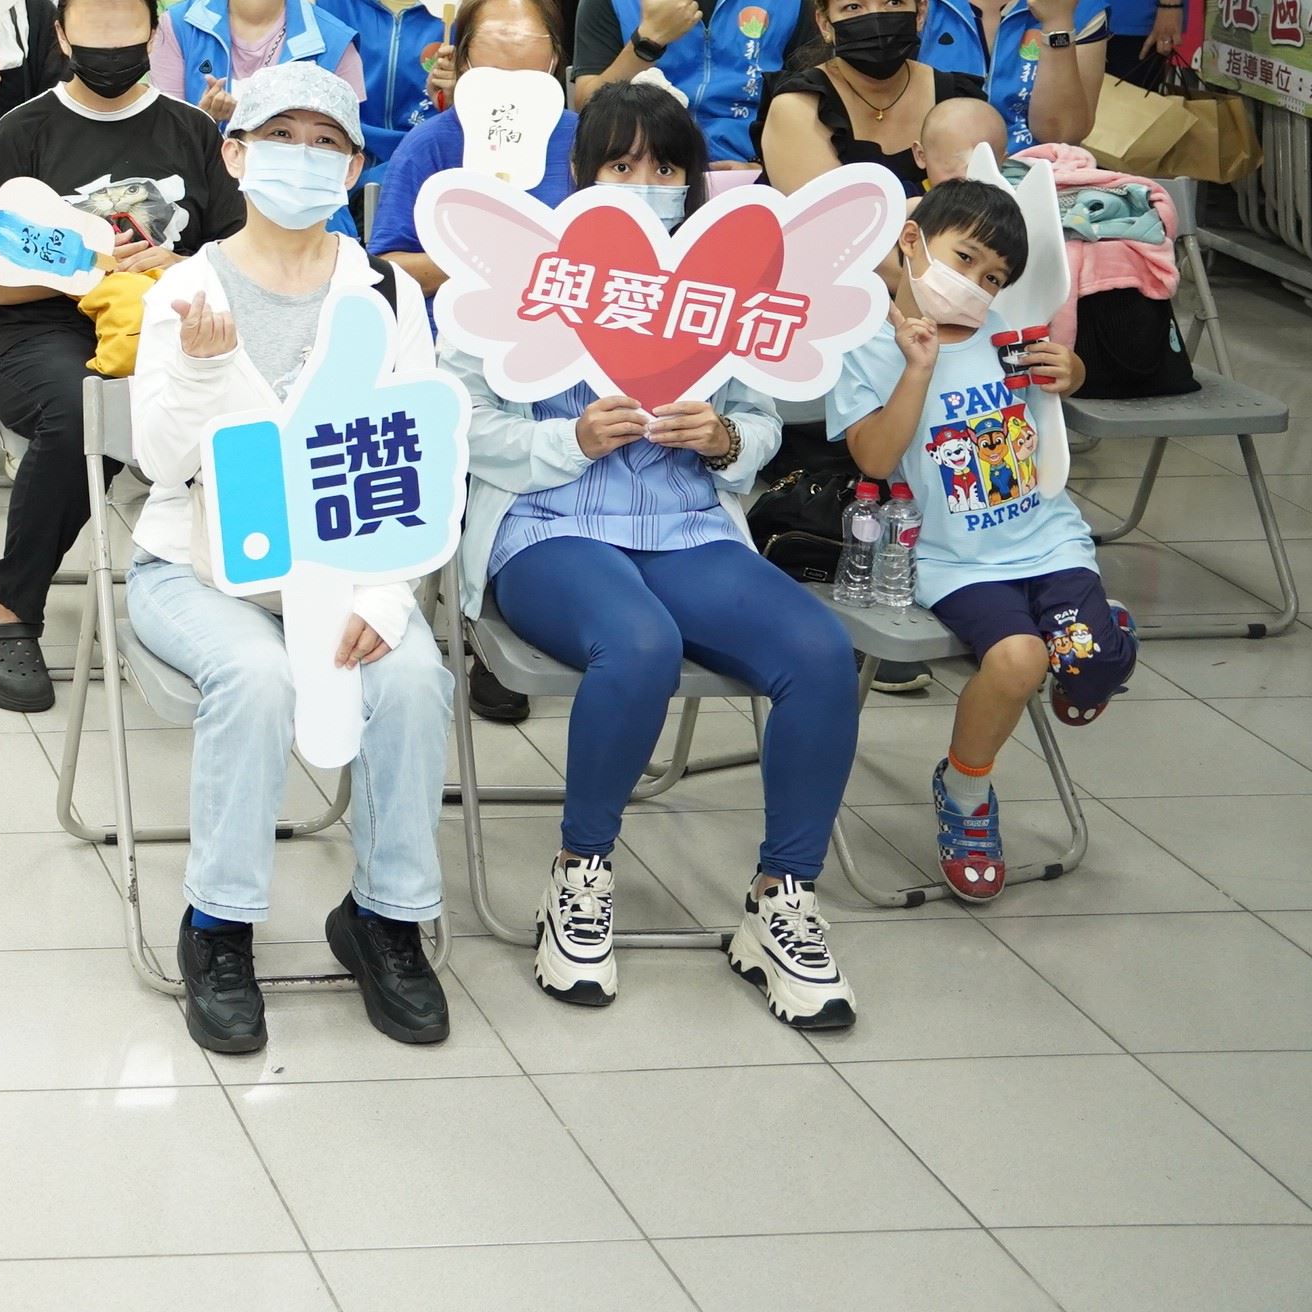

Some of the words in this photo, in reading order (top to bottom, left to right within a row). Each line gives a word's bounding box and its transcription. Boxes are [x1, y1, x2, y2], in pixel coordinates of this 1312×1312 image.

[527, 256, 806, 358] 與愛同行
[939, 380, 1014, 420] PAW
[306, 410, 427, 542] 讚
[964, 493, 1041, 532] PATROL
[1053, 608, 1079, 623] PAW
